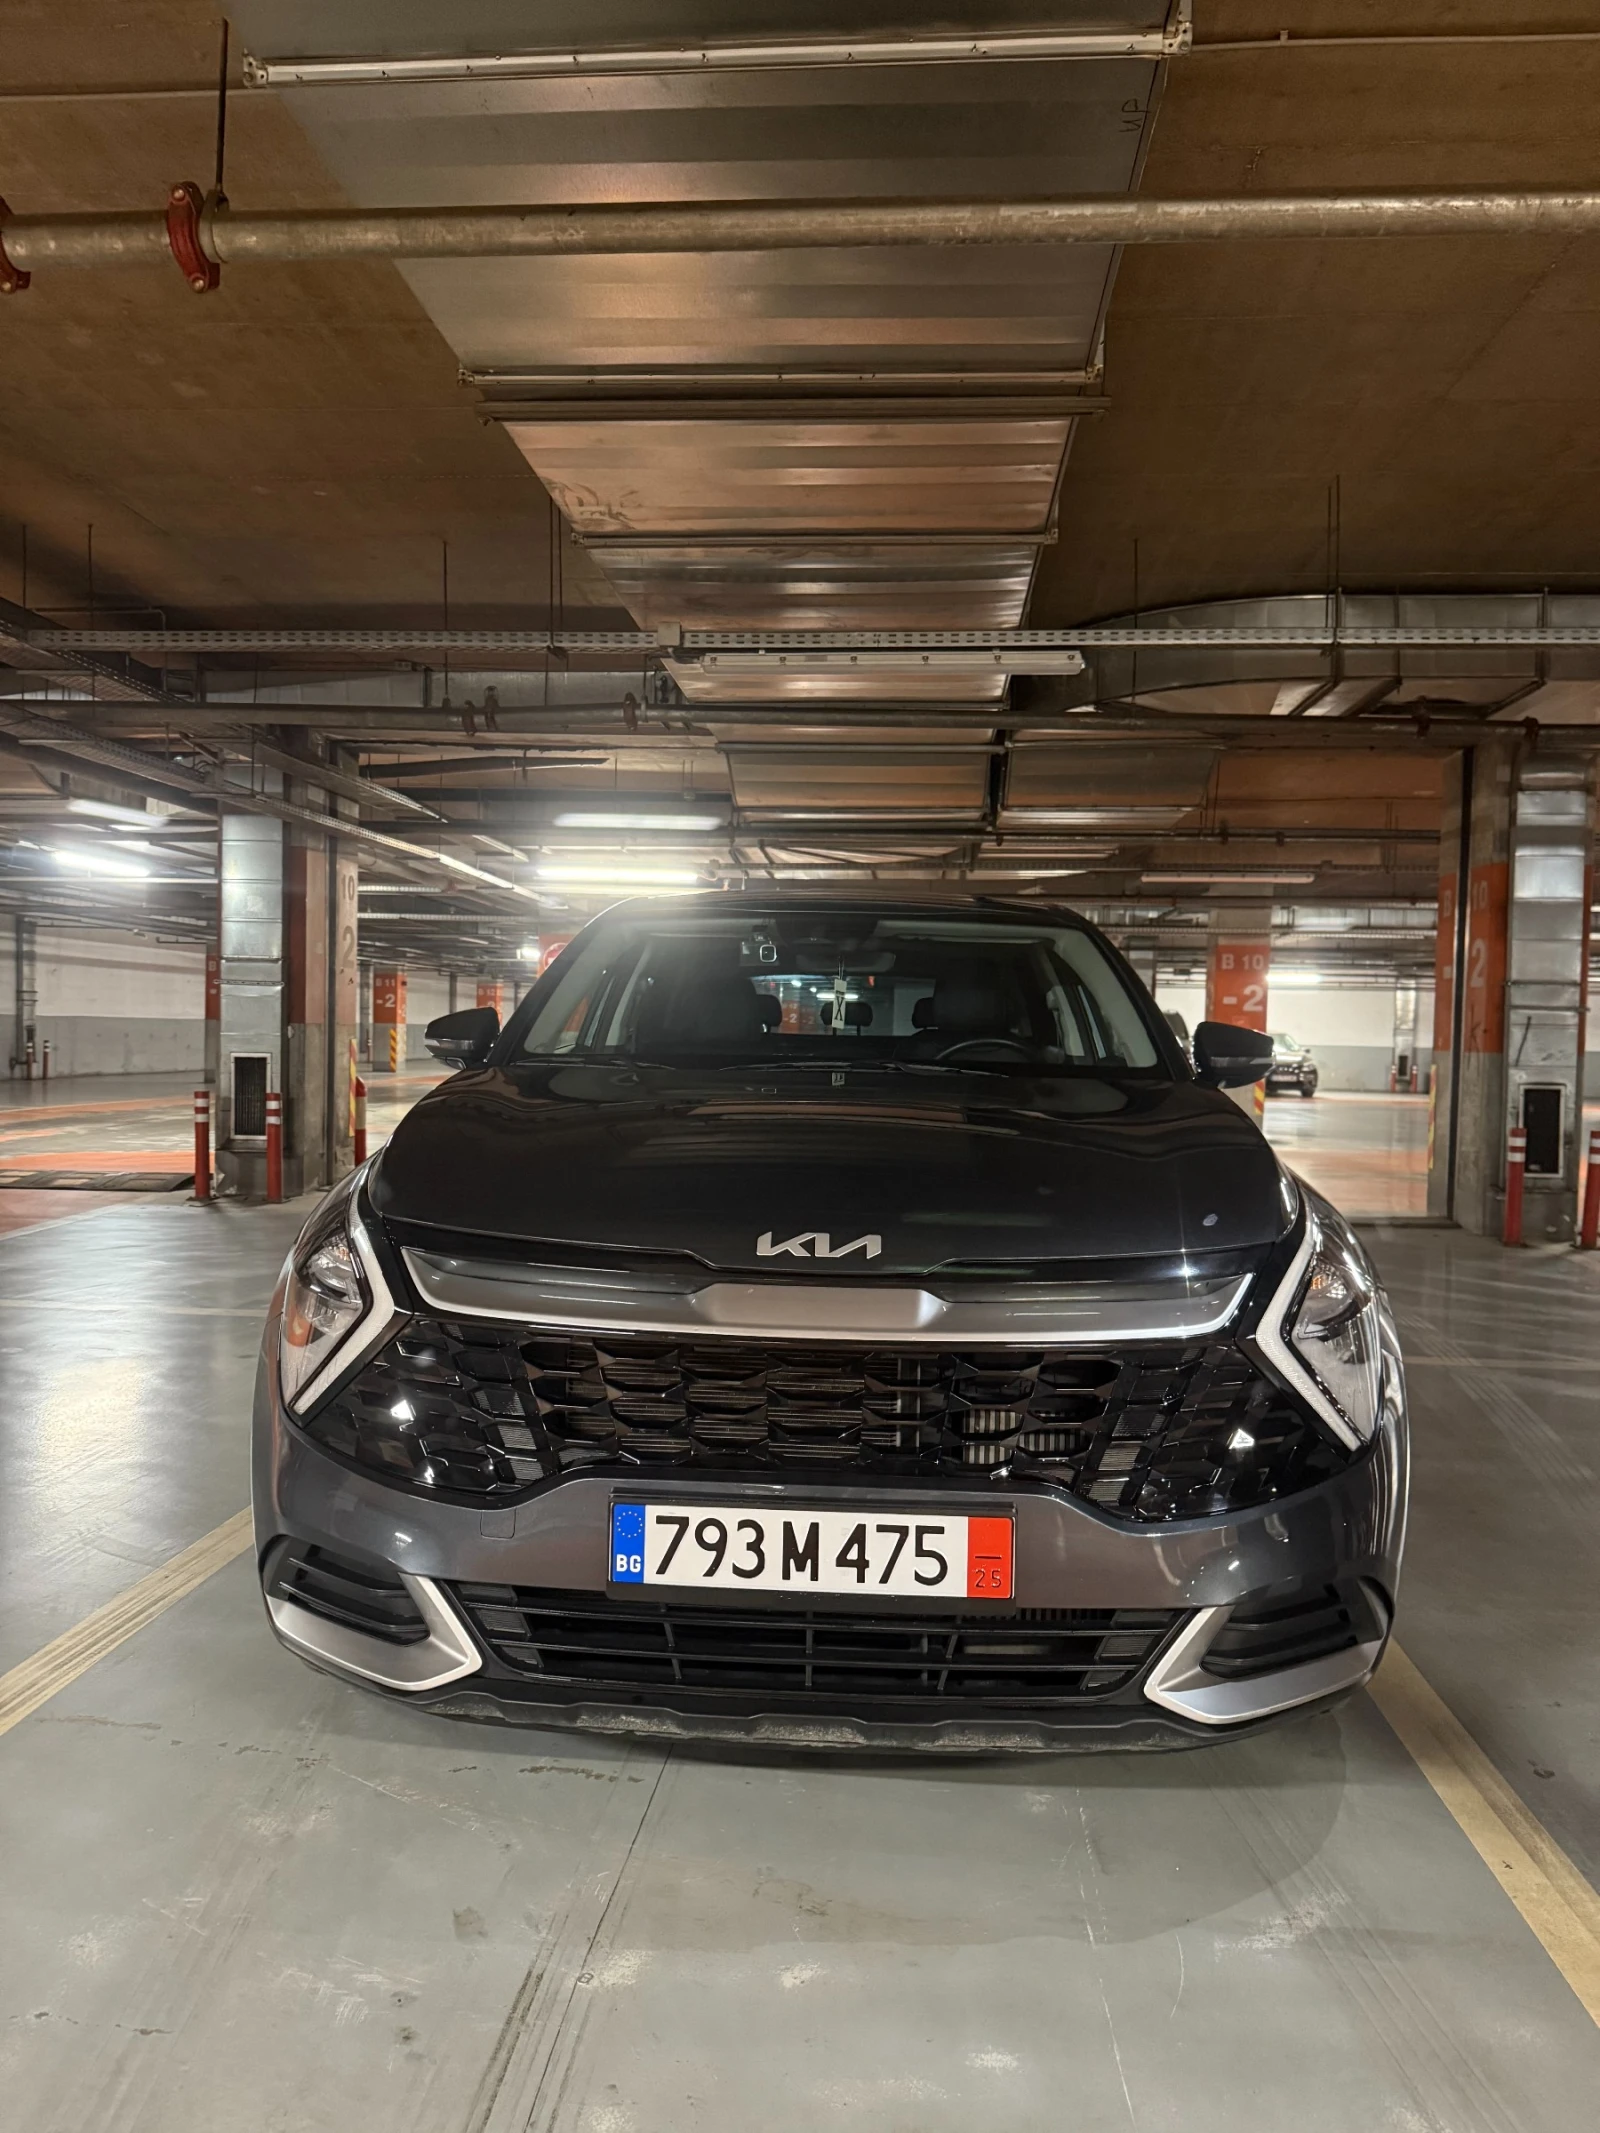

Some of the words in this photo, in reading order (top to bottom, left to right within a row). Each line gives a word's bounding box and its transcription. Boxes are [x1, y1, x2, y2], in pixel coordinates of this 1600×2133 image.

[341, 874, 355, 901] 10
[1472, 881, 1488, 912] 10
[1221, 953, 1235, 970] B
[1242, 954, 1264, 970] 10
[756, 1231, 882, 1259] KIA
[616, 1553, 642, 1573] BG
[655, 1515, 765, 1579] 793
[782, 1521, 819, 1581] M
[836, 1523, 948, 1586] 475
[975, 1568, 1002, 1588] 25
